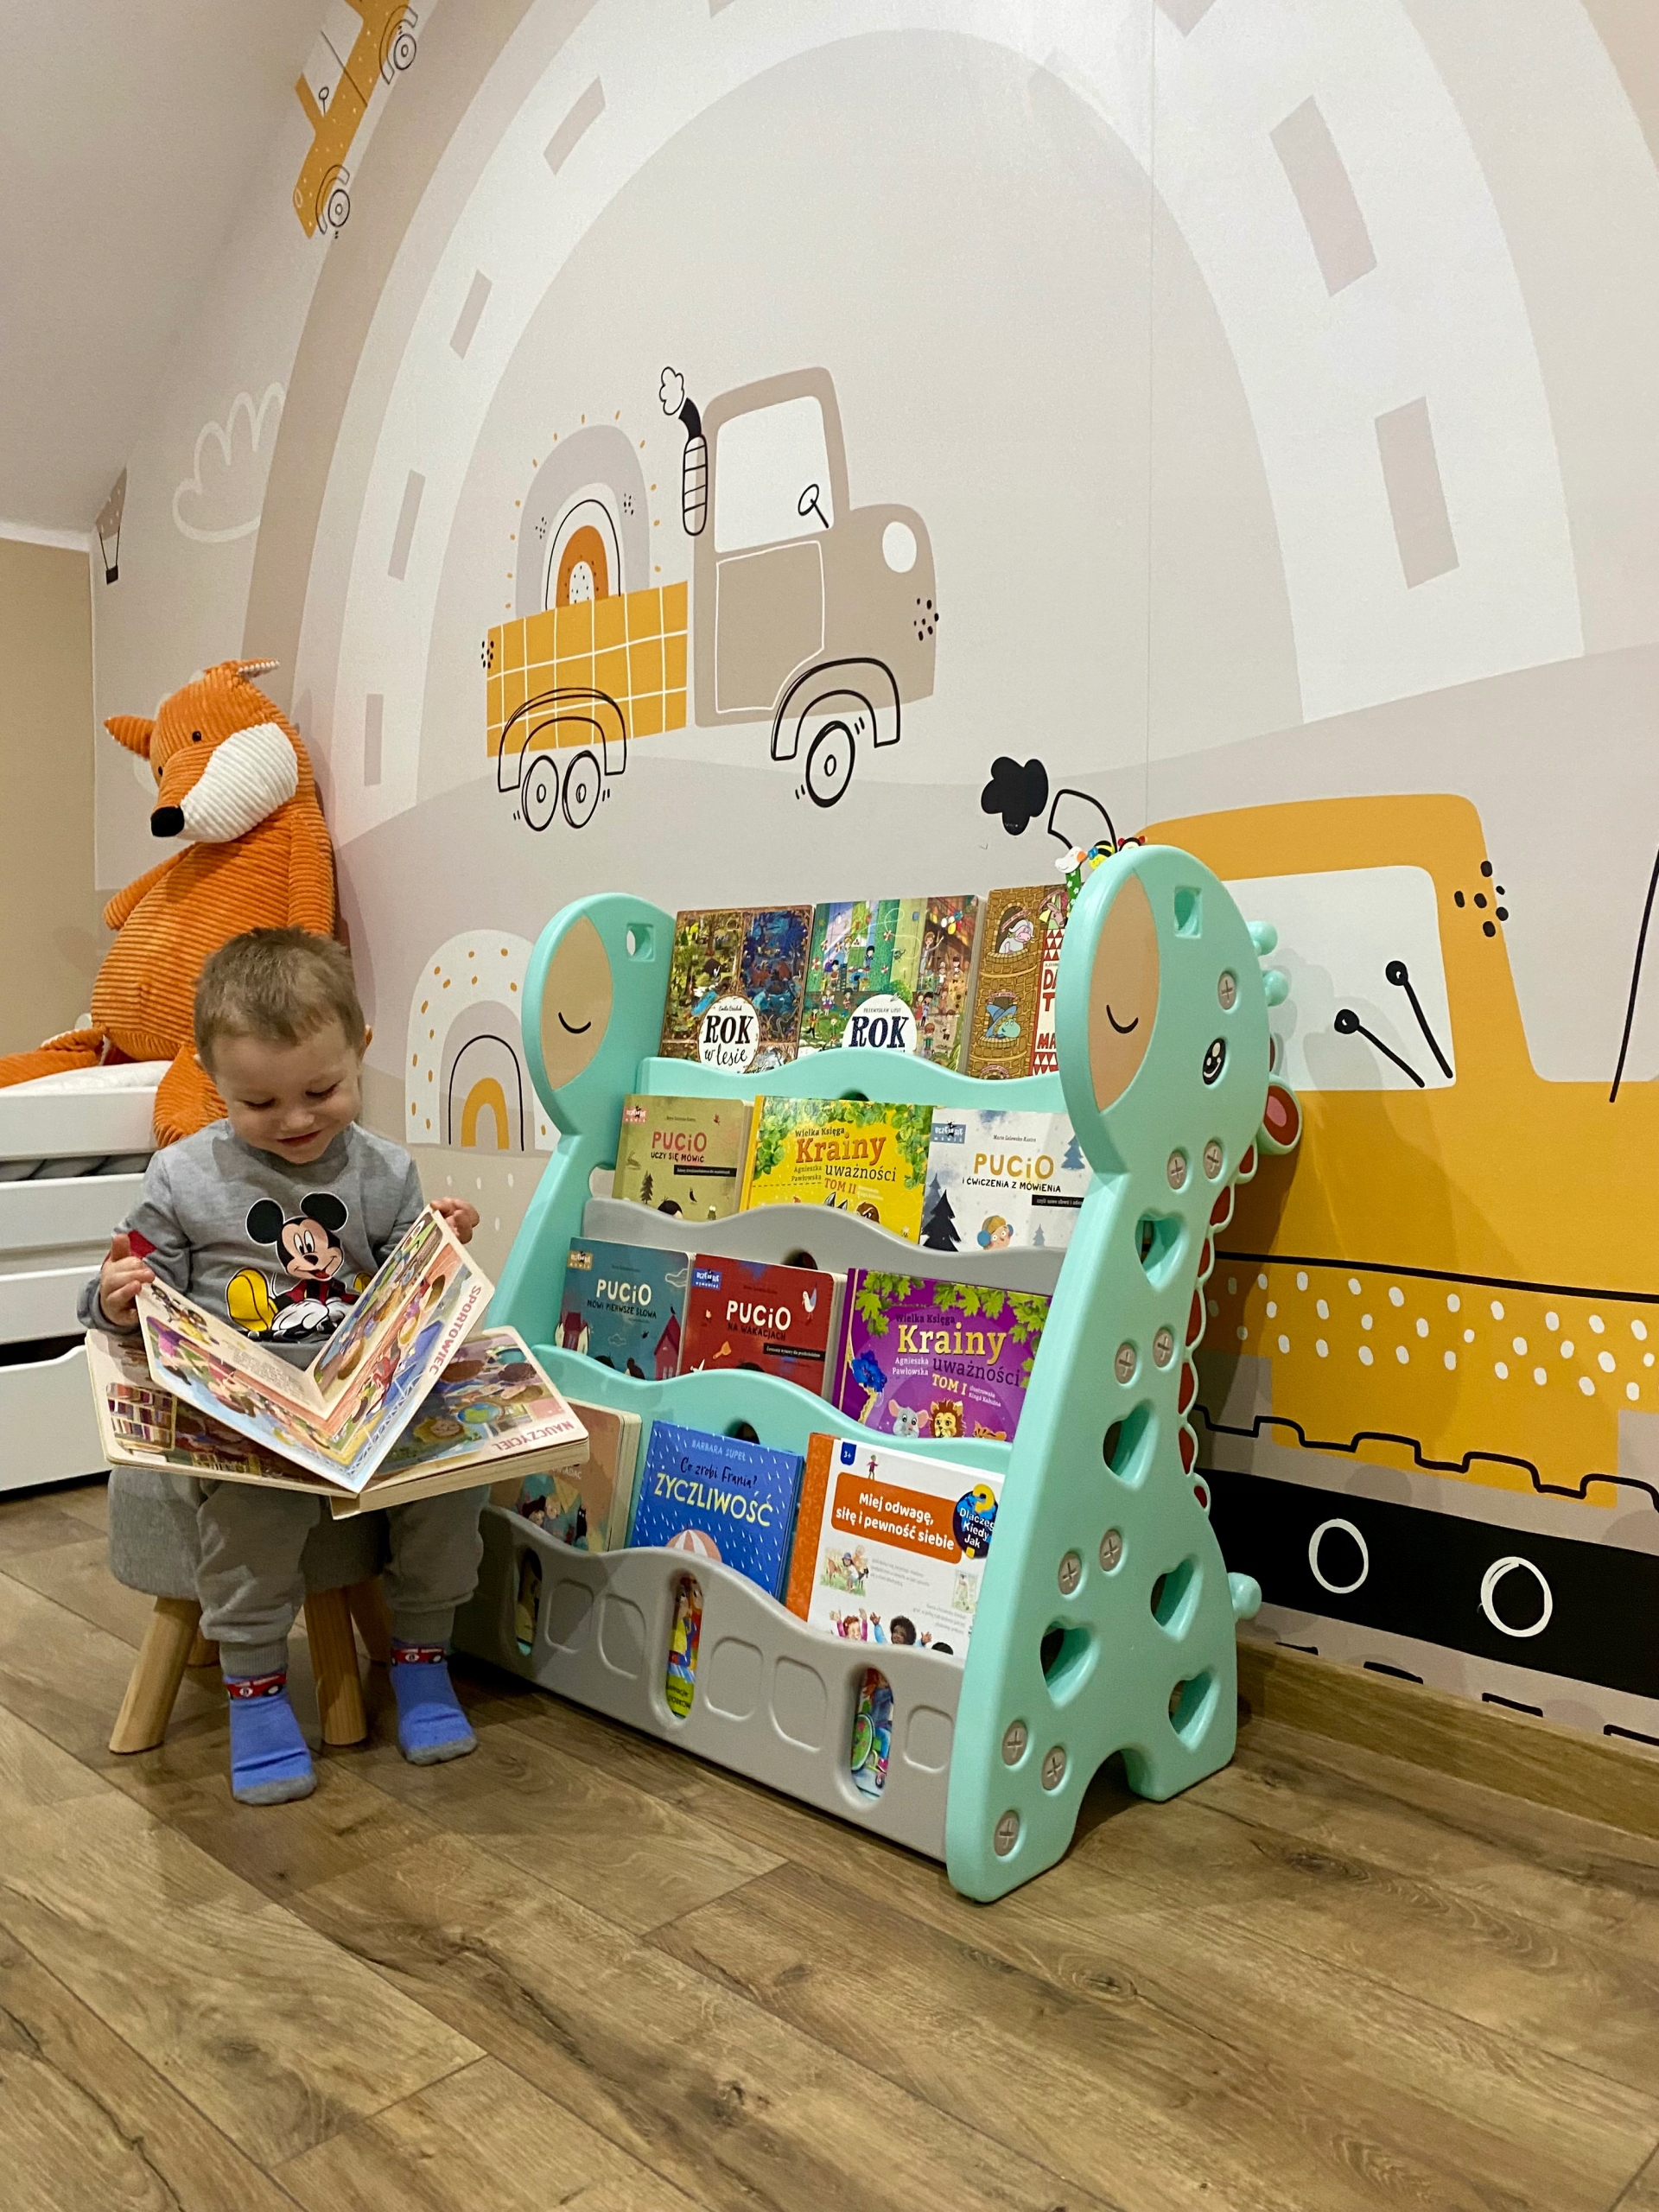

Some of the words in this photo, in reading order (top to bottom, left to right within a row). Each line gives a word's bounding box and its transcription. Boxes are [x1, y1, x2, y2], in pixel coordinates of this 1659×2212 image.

[703, 1015, 754, 1045] ROK
[848, 1015, 910, 1049] ROK
[704, 1048, 716, 1062] w
[716, 1043, 748, 1066] lesie
[795, 1128, 820, 1137] Wielka
[821, 1126, 845, 1137] Księga
[651, 1151, 666, 1160] UCZY
[796, 1132, 887, 1166] Krainy
[825, 1163, 897, 1183] uważności
[824, 1177, 846, 1192] TOM
[1011, 1180, 1017, 1190] Z
[429, 1285, 482, 1376] SPORTOWIEC
[728, 1322, 738, 1331] NA
[895, 1313, 925, 1324] Wielka
[926, 1314, 956, 1326] Księga
[897, 1322, 1007, 1366] Krainy
[892, 1367, 929, 1376] Pawłowska
[894, 1357, 929, 1368] Agnieszka
[932, 1357, 1020, 1388] uważności
[931, 1373, 960, 1394] TOM
[961, 1382, 968, 1395] I
[492, 1421, 575, 1451] NAUCZYCIEL
[691, 1439, 723, 1456] BARBARA
[842, 1450, 852, 1459] 3+
[680, 1456, 693, 1474] Co
[695, 1464, 718, 1479] zrobi
[654, 1465, 773, 1528] ŻYCZLIWOŚĆ
[859, 1492, 883, 1512] Miej
[884, 1500, 935, 1527] odwagę,
[836, 1506, 857, 1526] siłę
[858, 1512, 863, 1524] i
[864, 1515, 917, 1541] pewność
[918, 1530, 955, 1551] siebie
[963, 1520, 989, 1542] Kiedy
[964, 1534, 981, 1549] Jak
